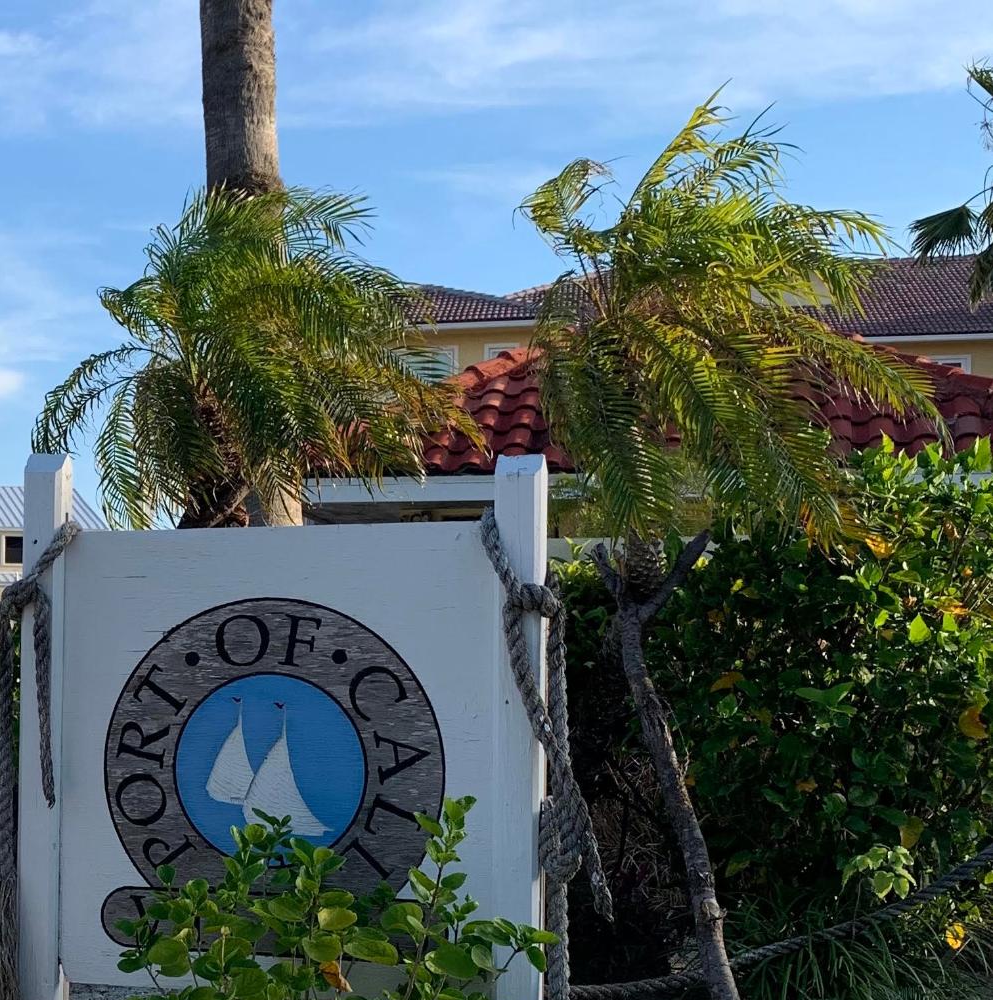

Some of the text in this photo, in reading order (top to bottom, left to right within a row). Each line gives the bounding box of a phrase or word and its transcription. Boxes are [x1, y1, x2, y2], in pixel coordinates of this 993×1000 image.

[114, 614, 432, 881] PORT OF CALL
